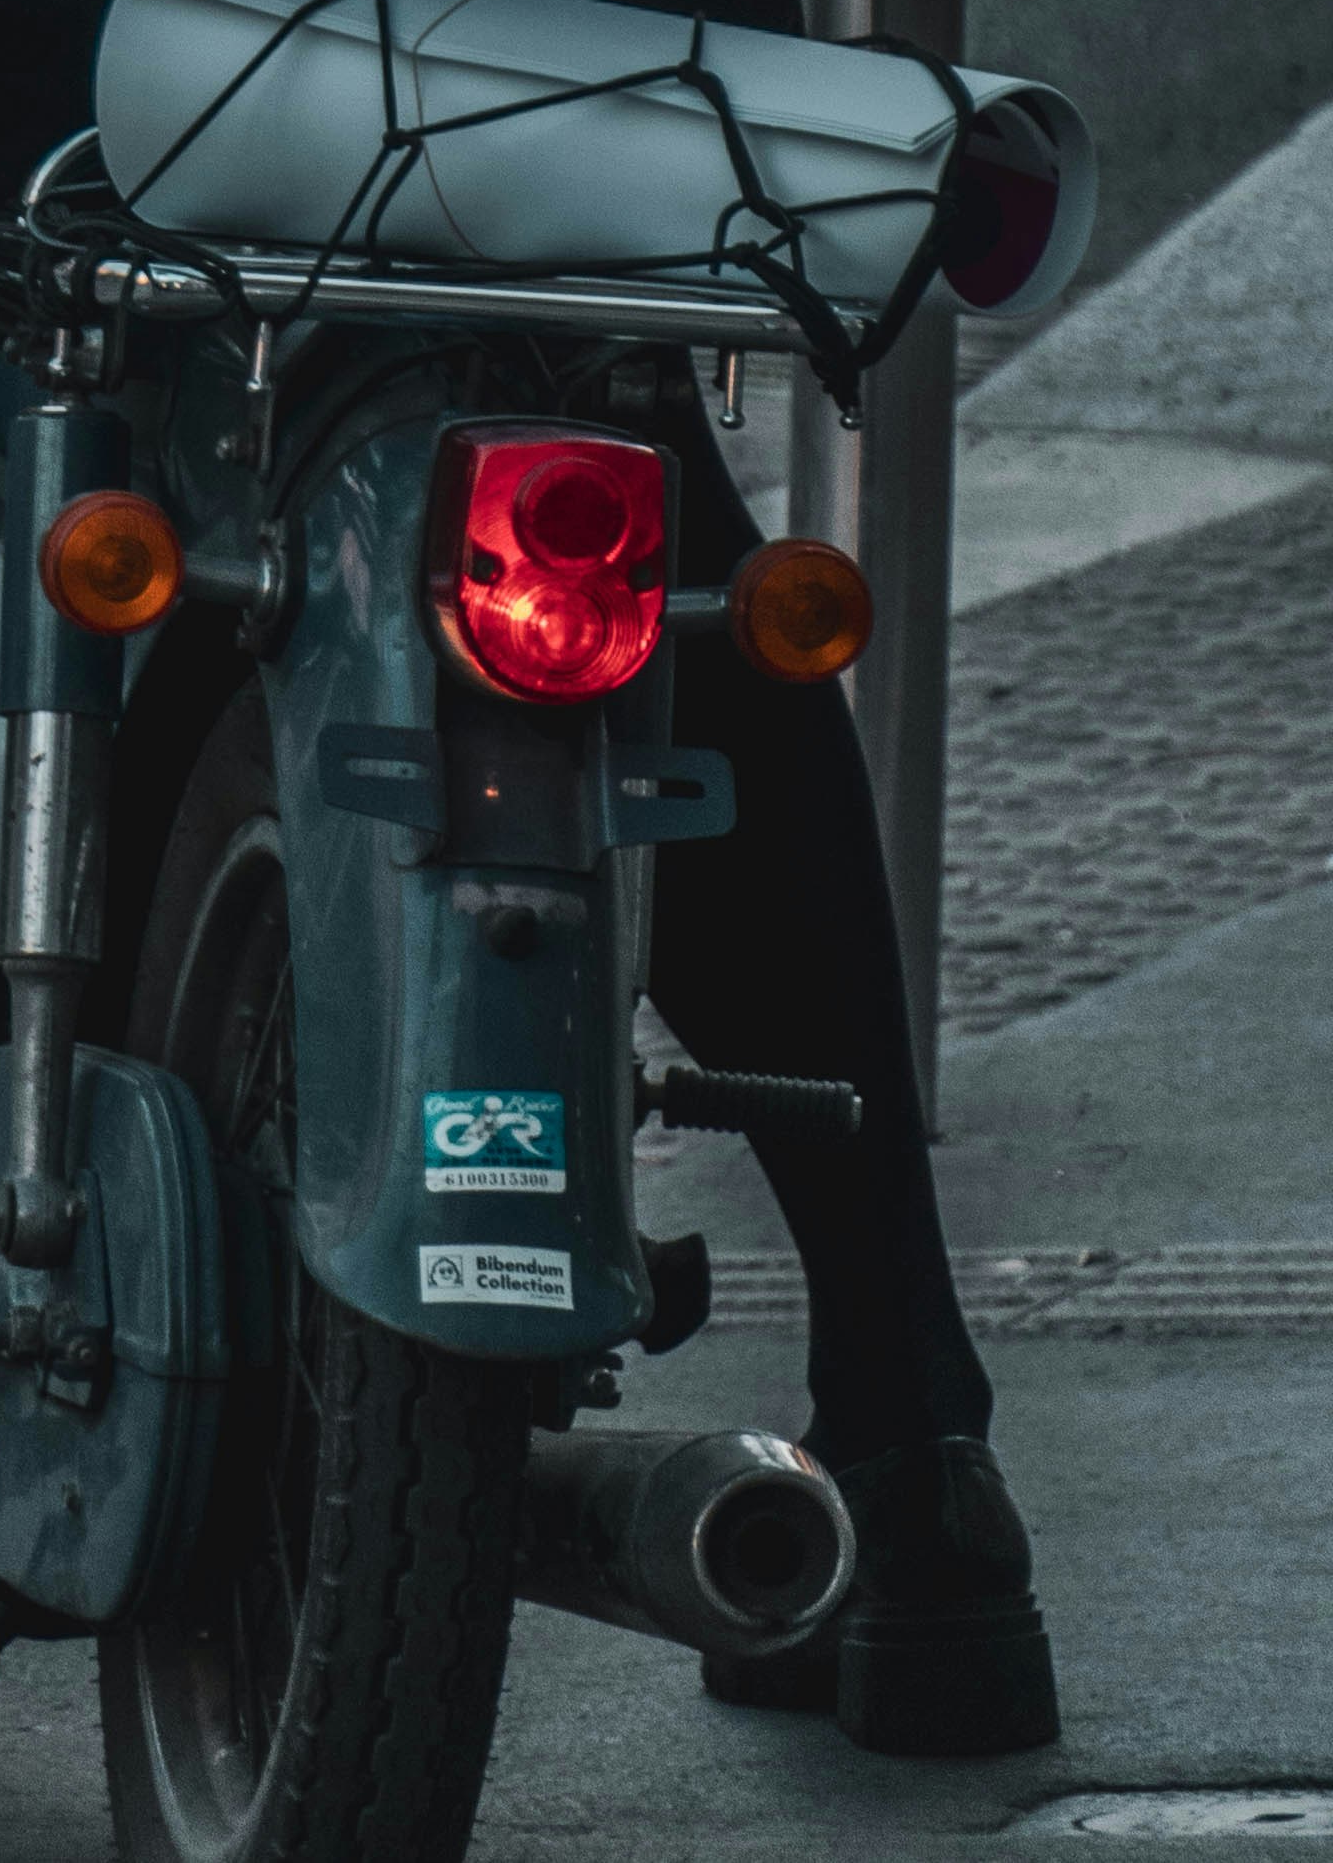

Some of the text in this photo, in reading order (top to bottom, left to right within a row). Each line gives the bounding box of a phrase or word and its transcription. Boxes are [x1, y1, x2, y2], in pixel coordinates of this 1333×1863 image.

[445, 1174, 548, 1186] 6100315300
[476, 1255, 564, 1277] Bibendum
[476, 1274, 565, 1295] Collection
